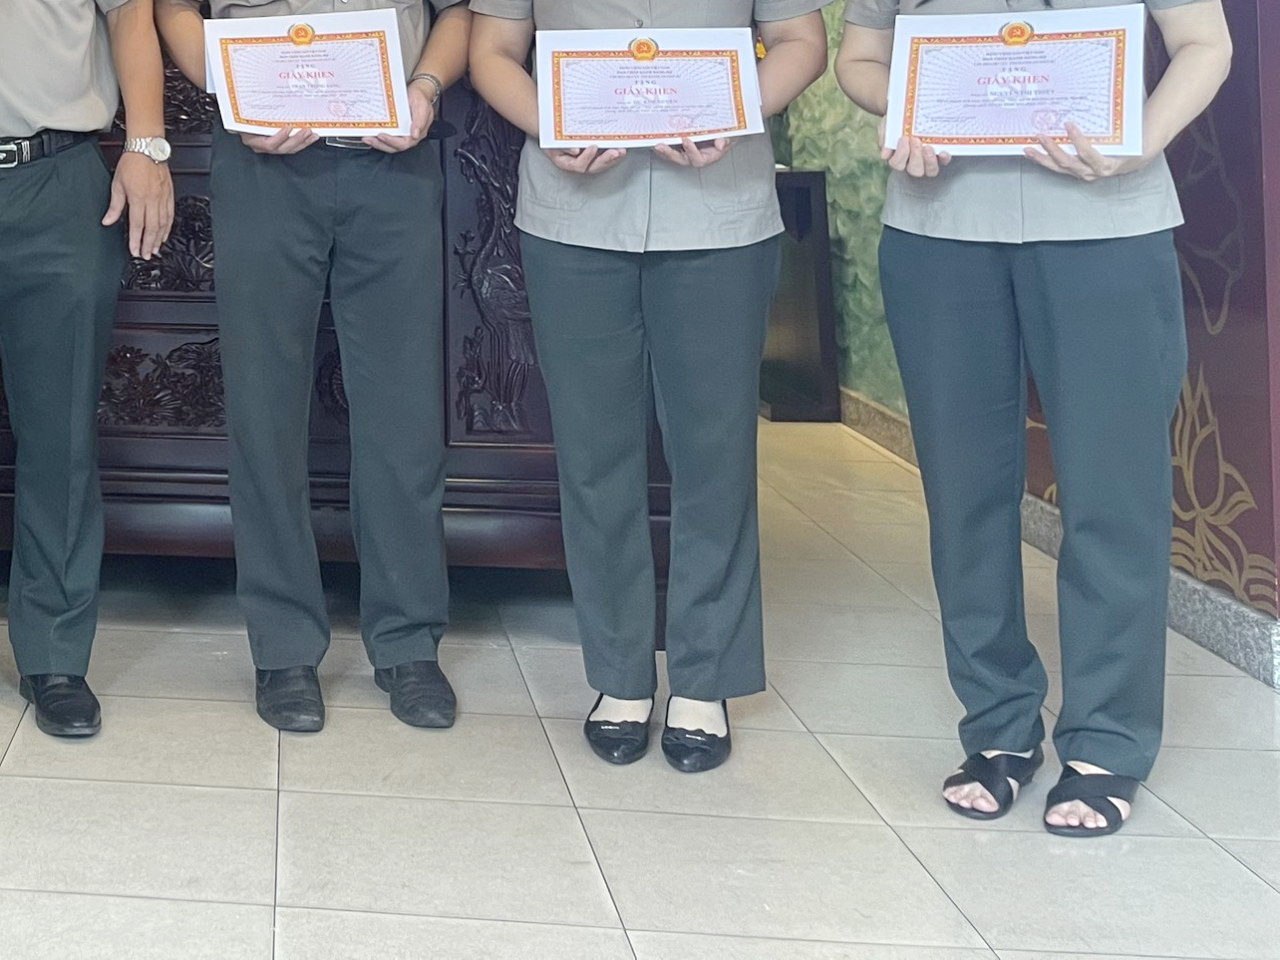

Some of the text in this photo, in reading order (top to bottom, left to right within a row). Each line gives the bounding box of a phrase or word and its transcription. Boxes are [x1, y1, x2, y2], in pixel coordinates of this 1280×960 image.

[306, 71, 335, 80] KHEN
[1012, 75, 1050, 85] KHEN
[645, 87, 678, 96] KHEN
